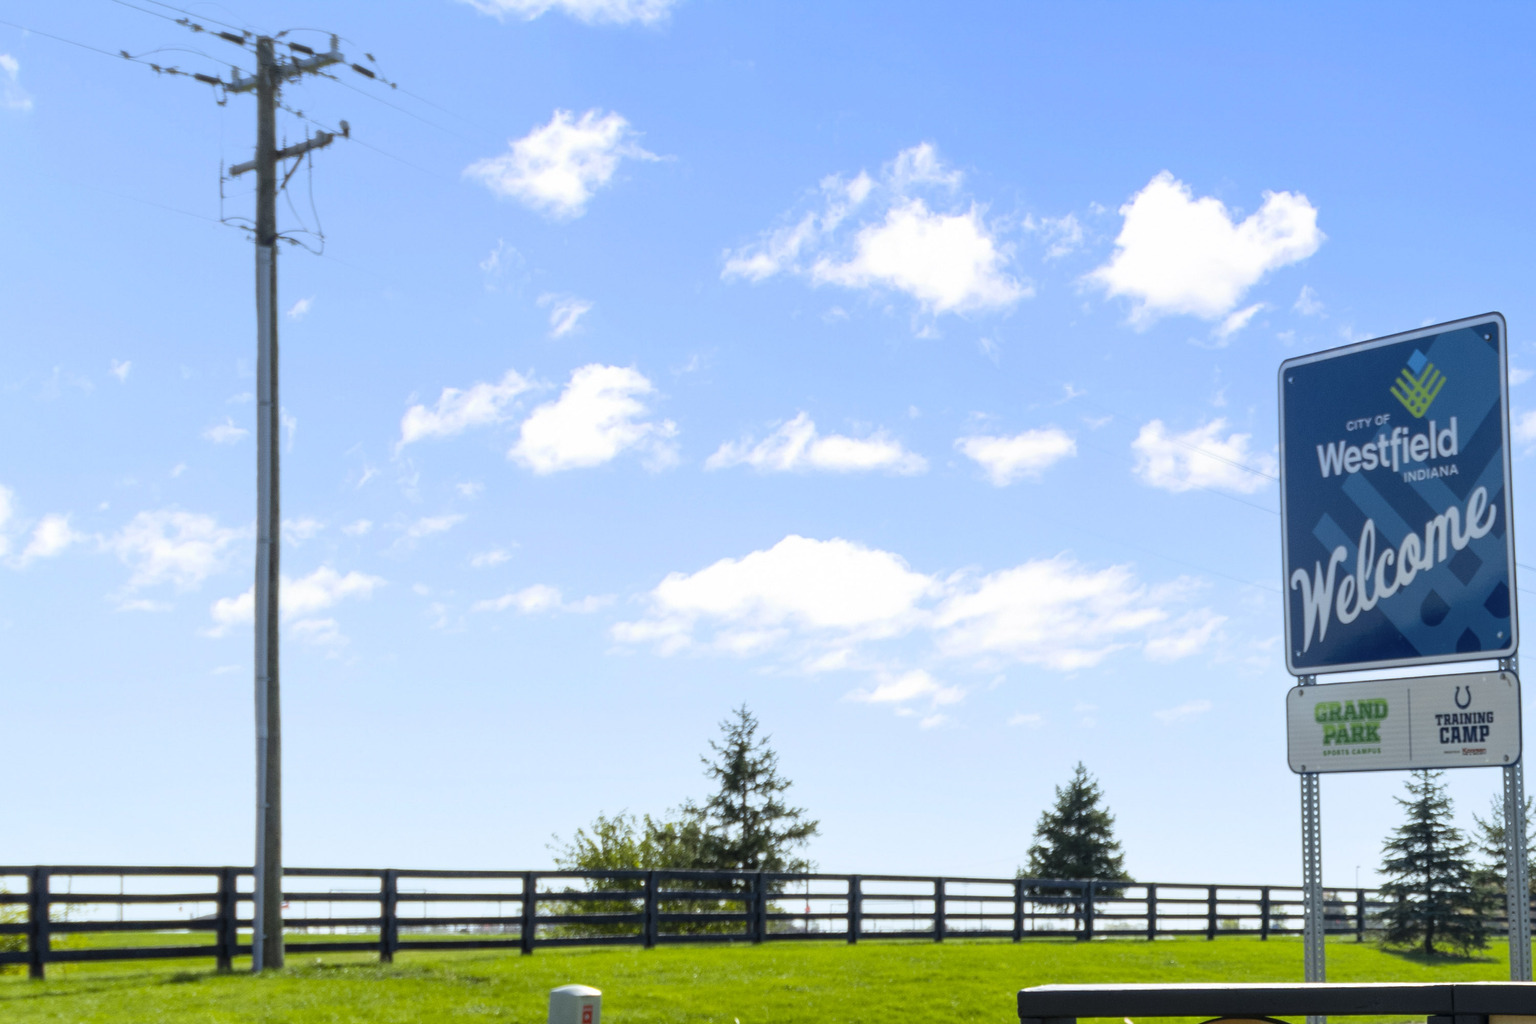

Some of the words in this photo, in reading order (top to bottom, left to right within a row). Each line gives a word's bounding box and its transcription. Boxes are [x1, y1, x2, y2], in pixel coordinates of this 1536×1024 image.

[1346, 418, 1372, 432] CITY
[1374, 414, 1391, 426] OF
[1316, 416, 1459, 479] Westfield
[1403, 464, 1460, 483] INDIANA
[1291, 486, 1497, 653] Welcome
[1314, 697, 1389, 724] GRAND
[1435, 711, 1494, 726] TRAINING
[1323, 722, 1382, 746] PARK
[1439, 724, 1490, 744] CAMP
